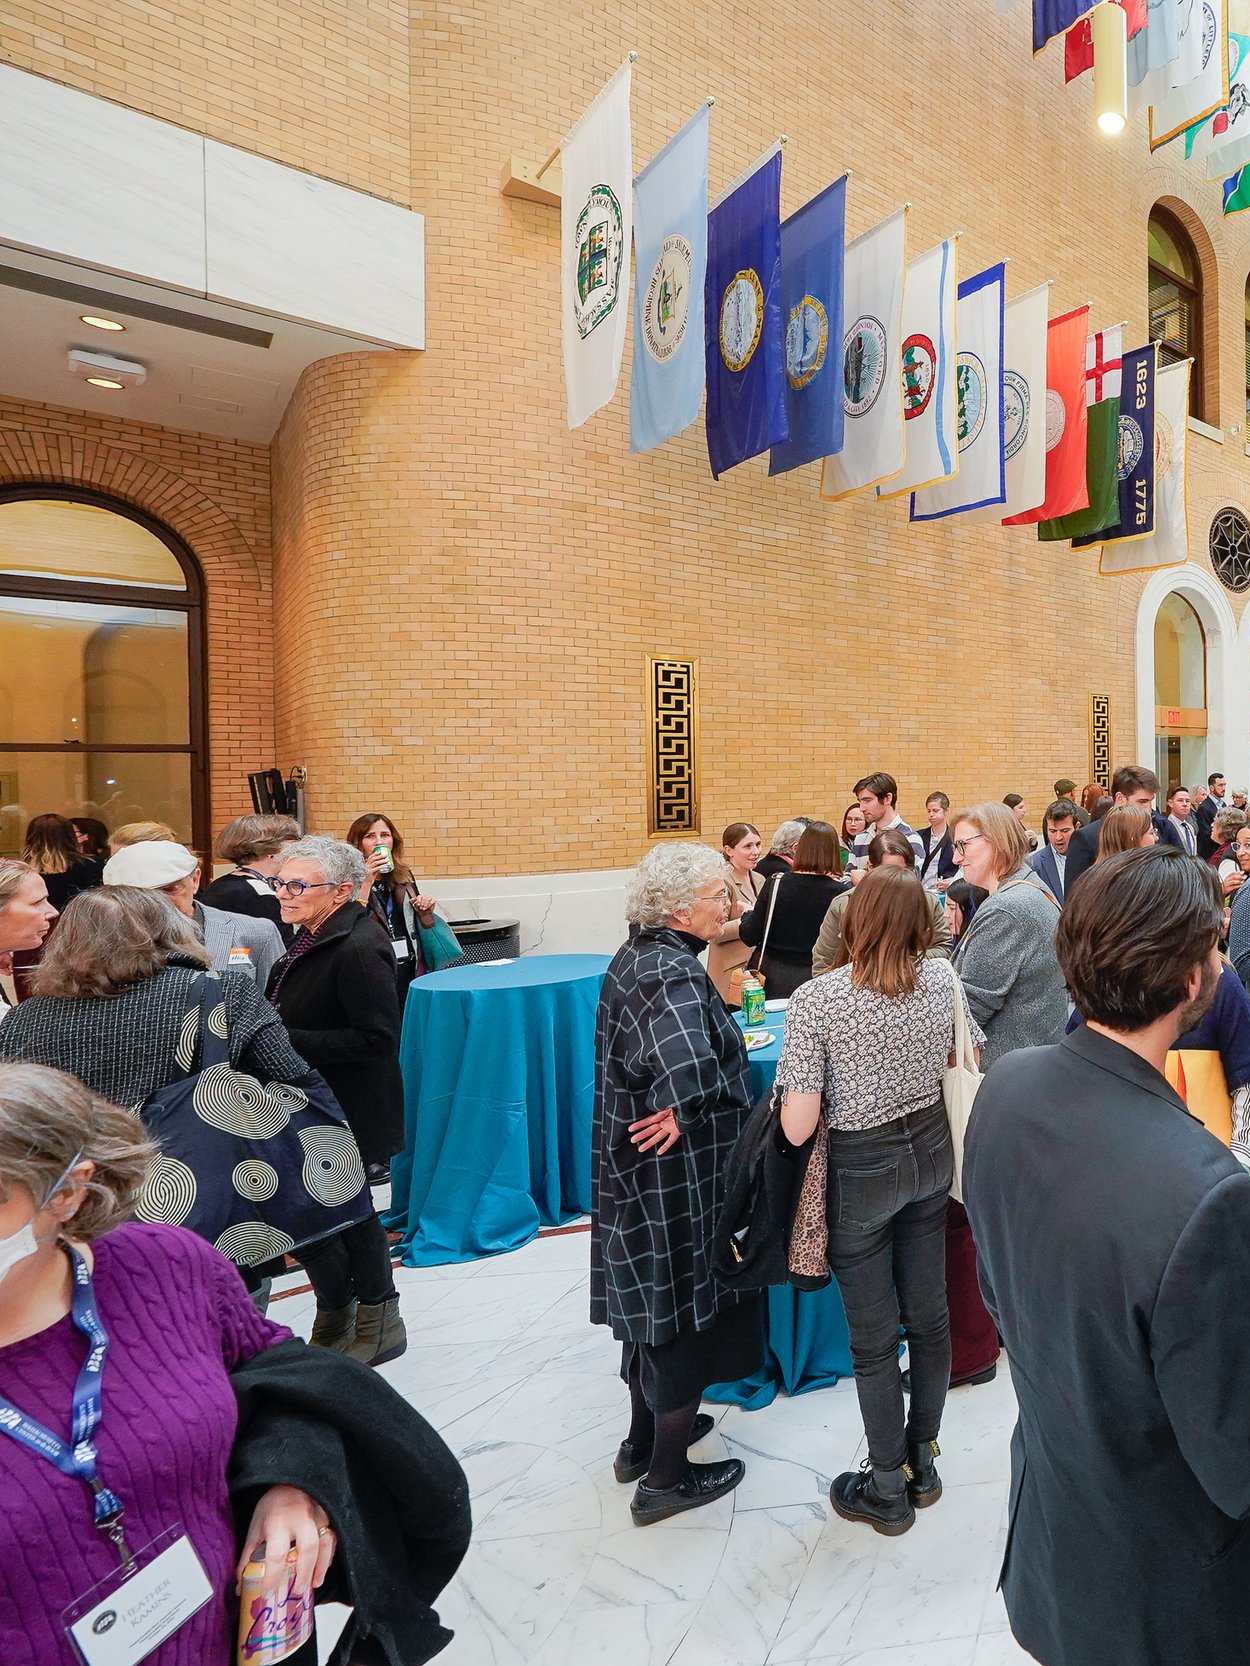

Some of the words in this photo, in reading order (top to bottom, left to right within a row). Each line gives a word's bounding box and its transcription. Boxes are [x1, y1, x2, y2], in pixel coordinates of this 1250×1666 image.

[1202, 25, 1214, 69] LITTLETO
[1136, 359, 1147, 410] 1623
[1135, 478, 1147, 525] 1775
[121, 1578, 172, 1623] HEATHER
[131, 1591, 173, 1629] KAMINS
